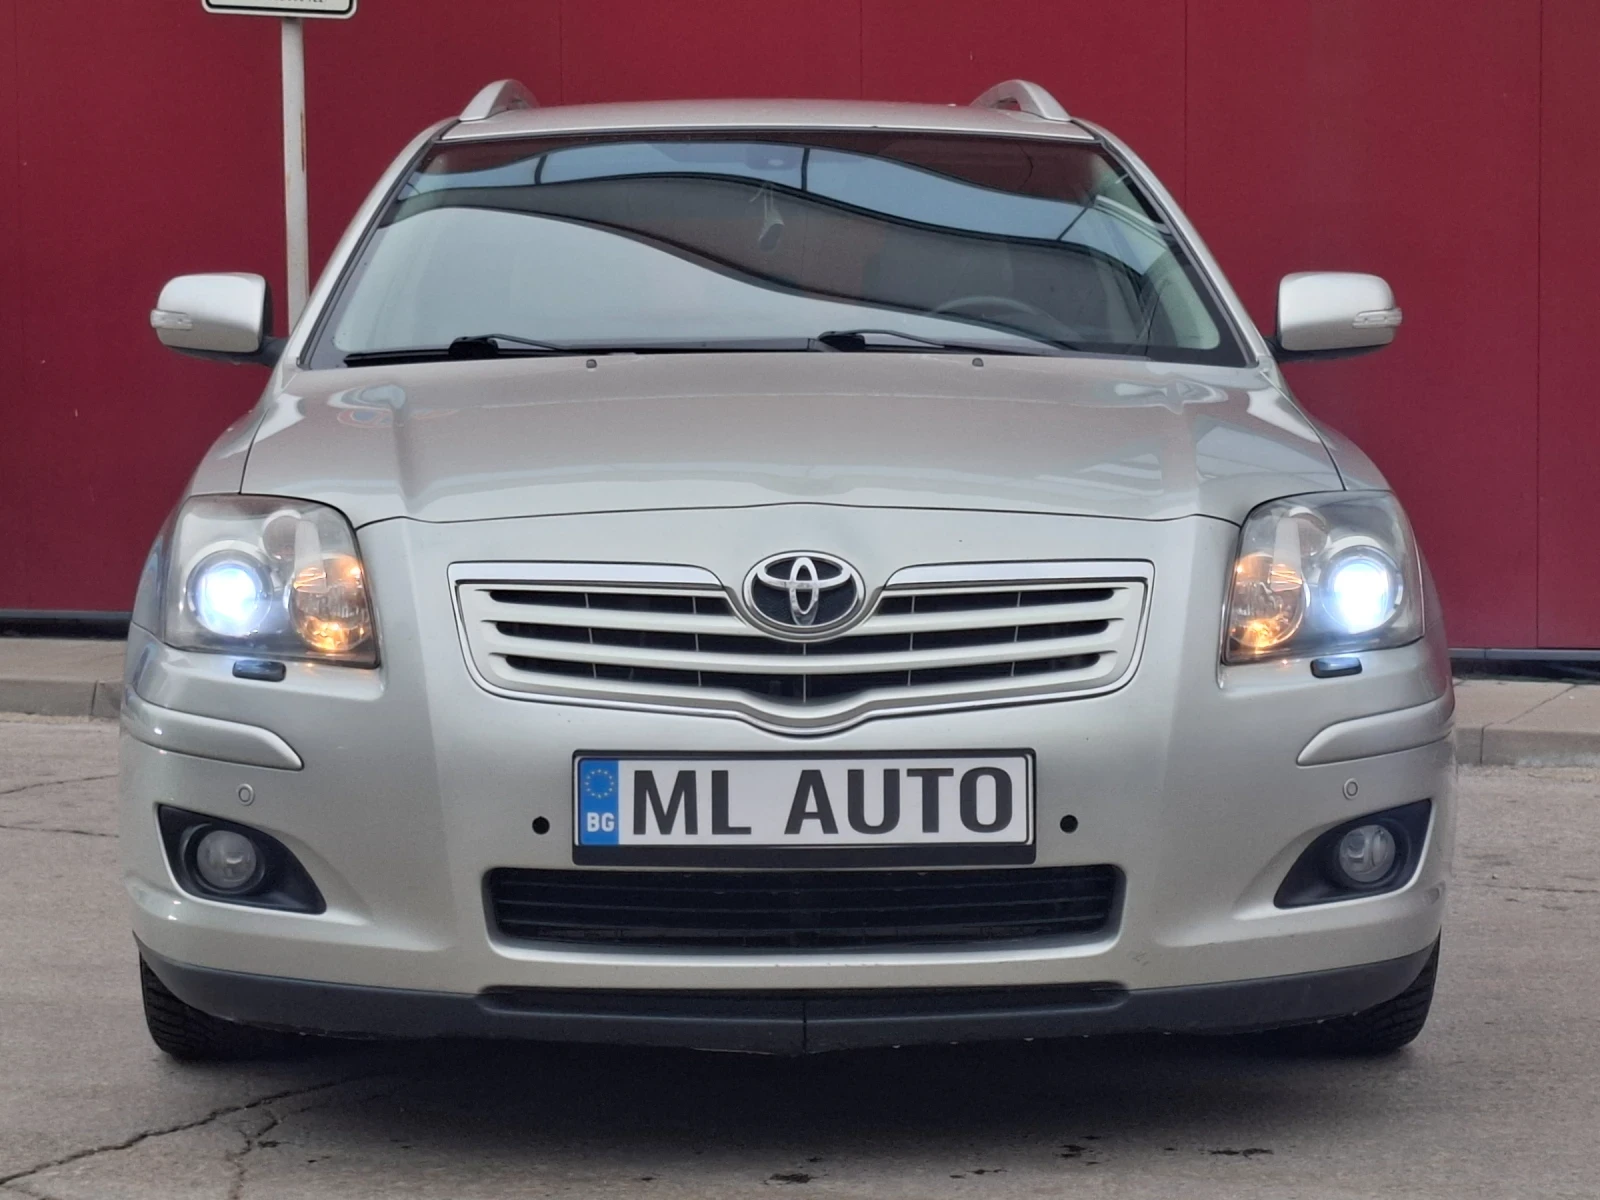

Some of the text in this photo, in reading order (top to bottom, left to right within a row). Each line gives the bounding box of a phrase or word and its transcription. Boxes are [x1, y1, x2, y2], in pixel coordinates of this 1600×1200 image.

[586, 812, 615, 832] BG
[633, 767, 1013, 835] ML AUTO
